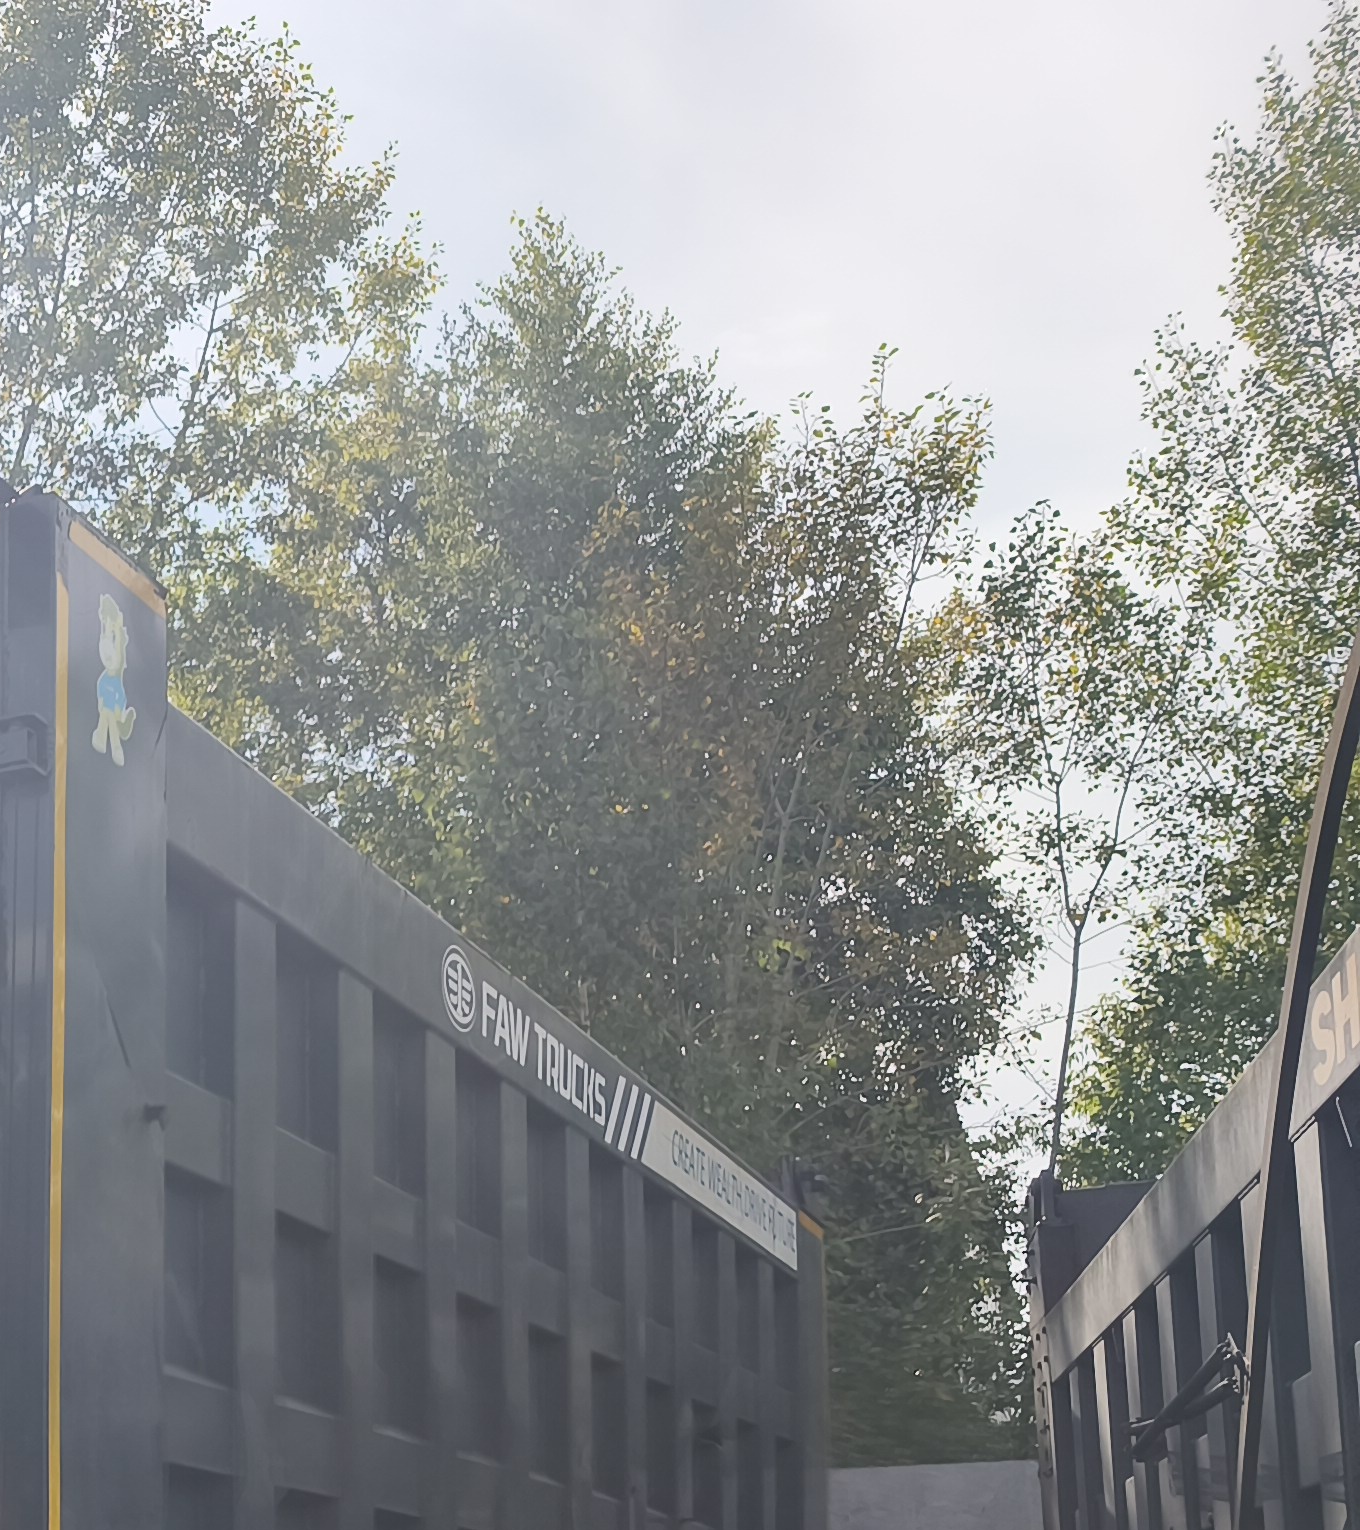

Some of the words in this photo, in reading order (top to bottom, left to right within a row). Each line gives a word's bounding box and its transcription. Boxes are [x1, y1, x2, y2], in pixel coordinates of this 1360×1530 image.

[481, 980, 531, 1067] FAW
[534, 1024, 607, 1127] TRUCKS
[671, 1129, 706, 1187] CREATE
[707, 1155, 744, 1213] WEALTH
